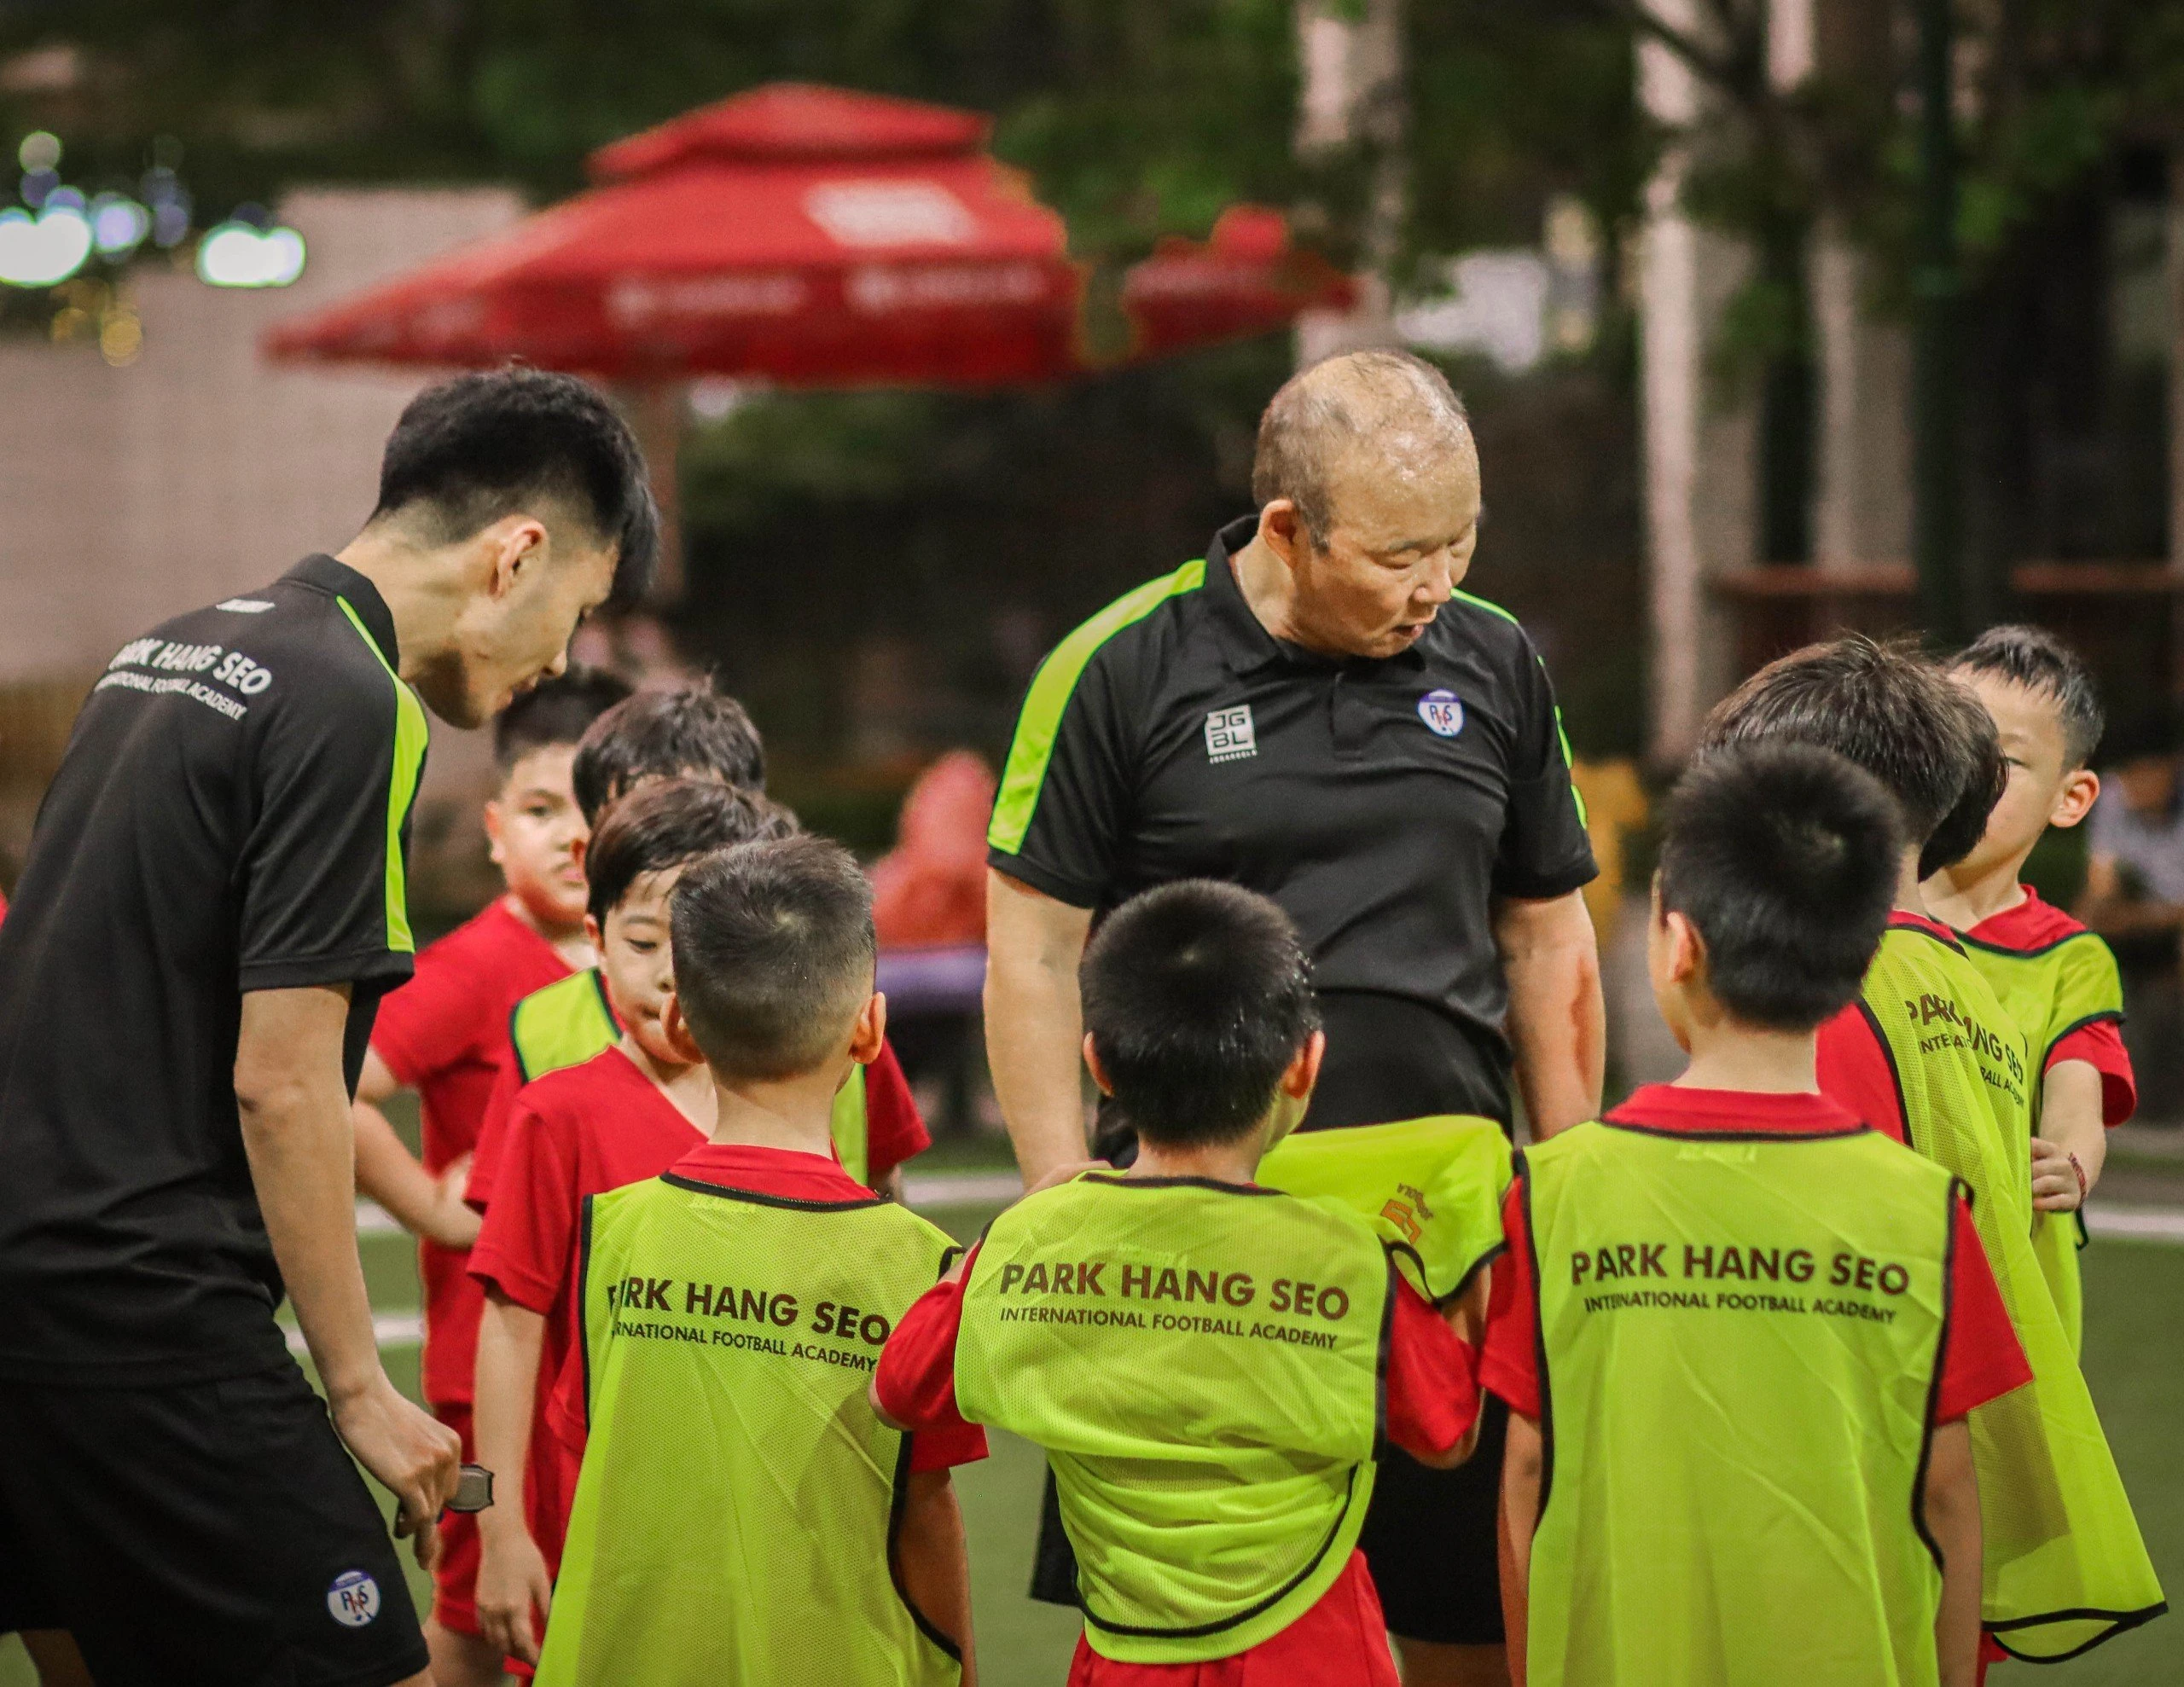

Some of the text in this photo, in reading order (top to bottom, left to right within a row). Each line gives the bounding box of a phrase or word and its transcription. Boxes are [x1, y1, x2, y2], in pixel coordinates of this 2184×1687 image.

[152, 641, 224, 671] HANG
[212, 652, 272, 695] SEO
[187, 682, 247, 721] ACADEMY
[999, 1261, 1350, 1321] PARK HANG SEO
[1571, 1243, 1909, 1296] PARK HANG SEO
[685, 1281, 799, 1327] HANG
[811, 1301, 891, 1346] SEO
[1000, 1306, 1338, 1349] INTERNATIONAL FOOTBALL ACADEMY
[1716, 1294, 1807, 1313] FOOTBALL
[1812, 1299, 1897, 1324] ACADEMY
[712, 1330, 787, 1356] FOOTBALL
[792, 1342, 878, 1372] ACADEMY
